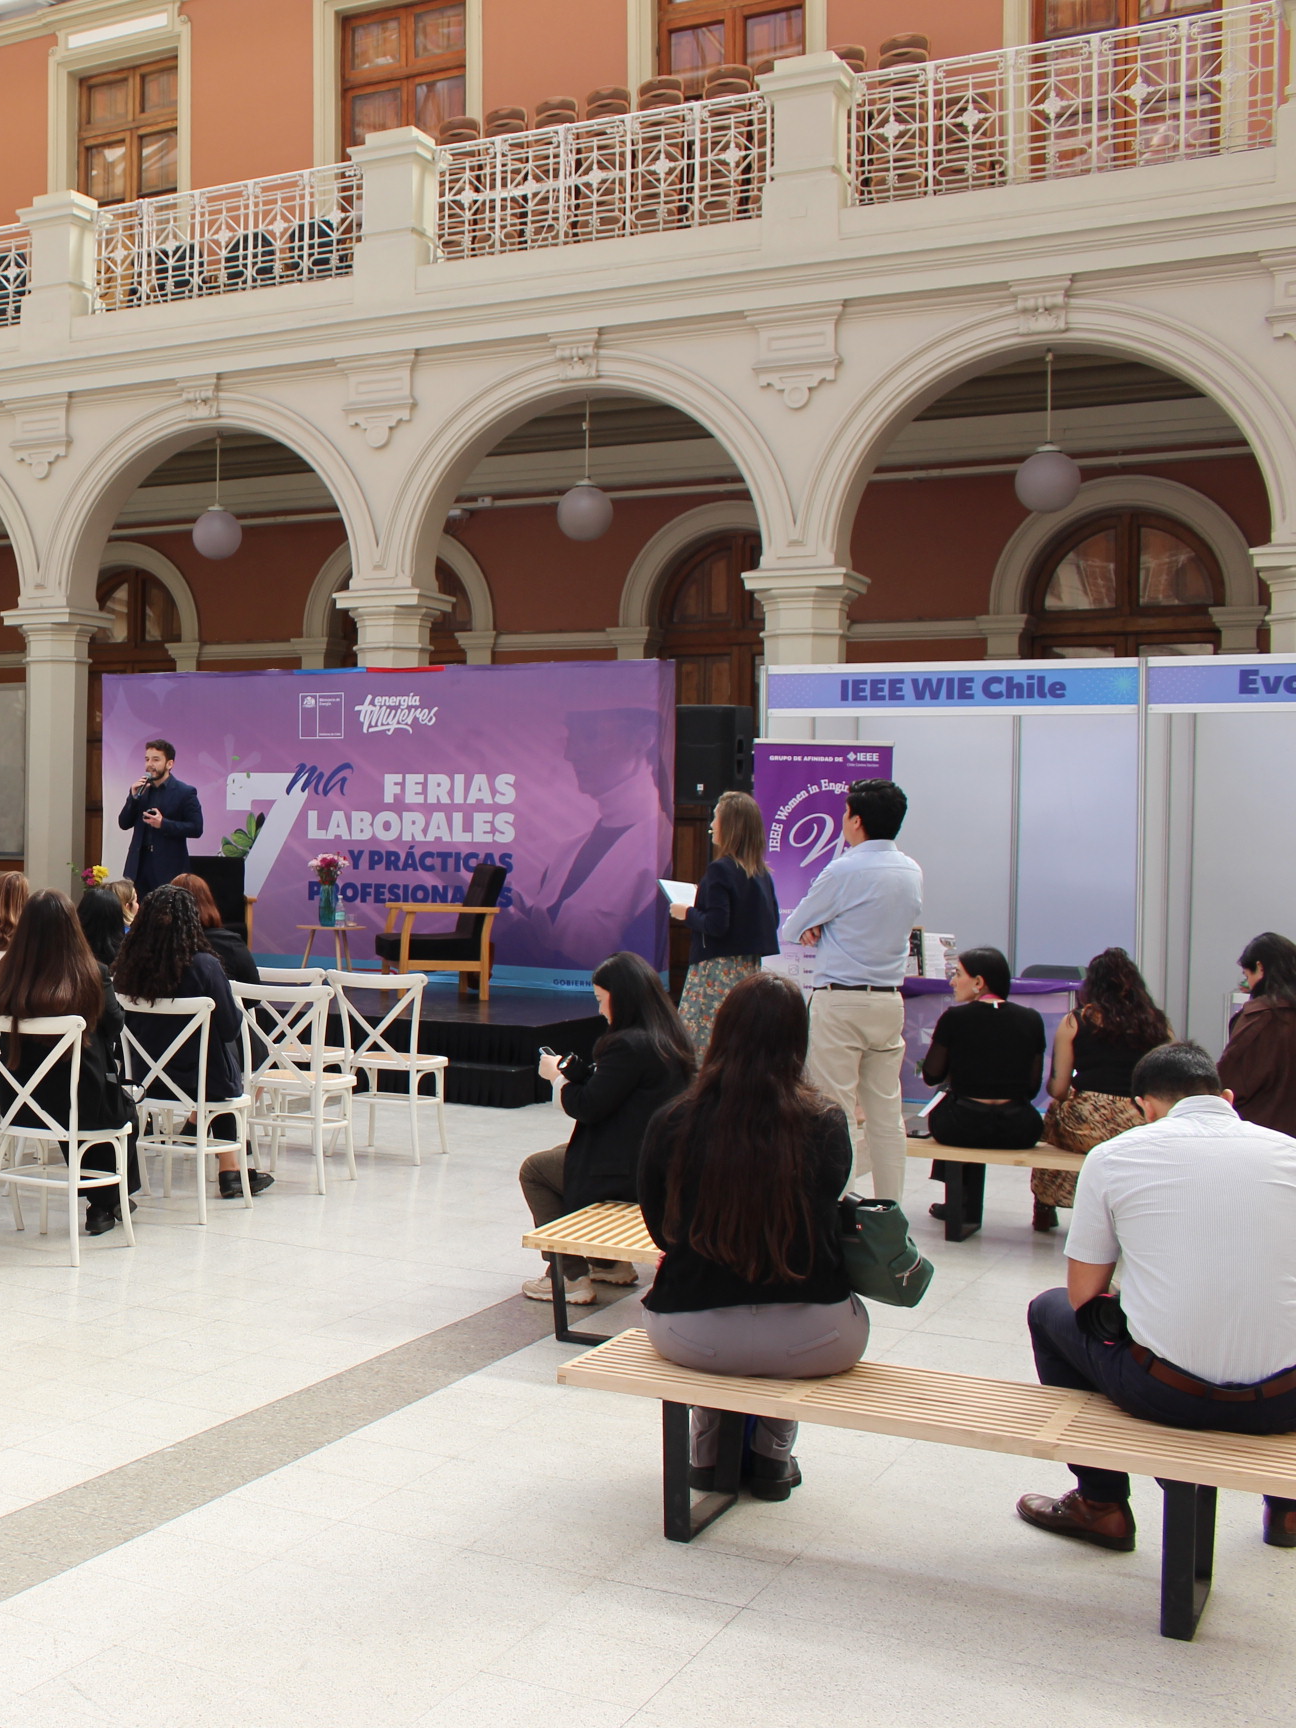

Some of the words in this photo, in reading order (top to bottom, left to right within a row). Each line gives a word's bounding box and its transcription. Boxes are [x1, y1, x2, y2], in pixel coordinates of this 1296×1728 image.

[374, 692, 420, 708] energía
[840, 678, 905, 702] IEEE
[911, 677, 975, 700] WIE
[981, 675, 1067, 699] Chile
[857, 752, 880, 761] IEEE
[383, 773, 516, 804] FERIAS
[807, 784, 820, 795] in
[775, 790, 809, 820] Women
[307, 810, 516, 843] LABORALES
[769, 822, 784, 853] IEEE
[348, 849, 365, 870] Y
[368, 845, 514, 875] PRÁCTICAS
[307, 880, 514, 908] POFESIONAS
[553, 979, 593, 987] GOBIERN
